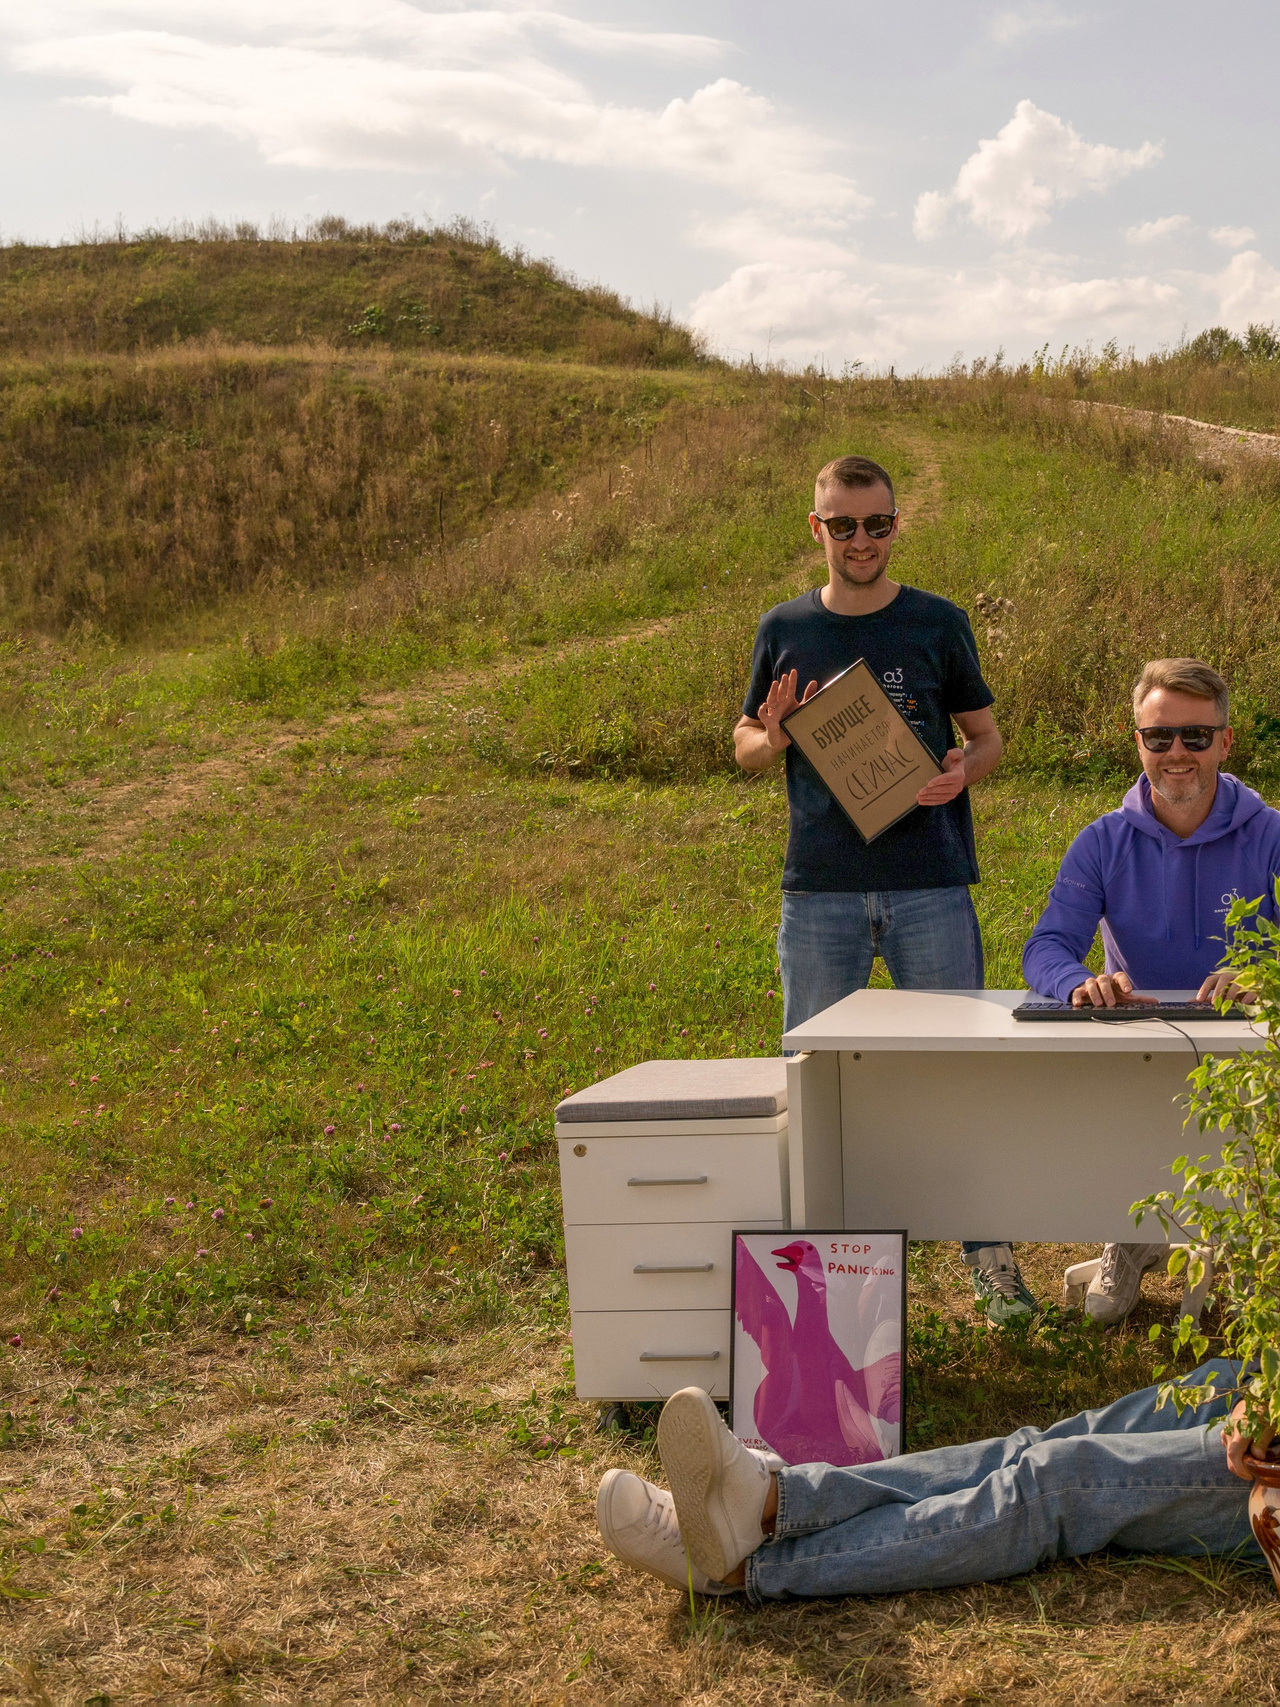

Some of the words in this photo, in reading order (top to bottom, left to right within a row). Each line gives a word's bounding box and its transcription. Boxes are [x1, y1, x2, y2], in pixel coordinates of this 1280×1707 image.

[811, 694, 876, 750] БУДУЩЕЕ
[830, 720, 892, 771] НАЧИНАЕТСЯ
[845, 739, 915, 800] СЕЙЧАС
[828, 1262, 895, 1276] PANICKING
[830, 1243, 871, 1254] STOP
